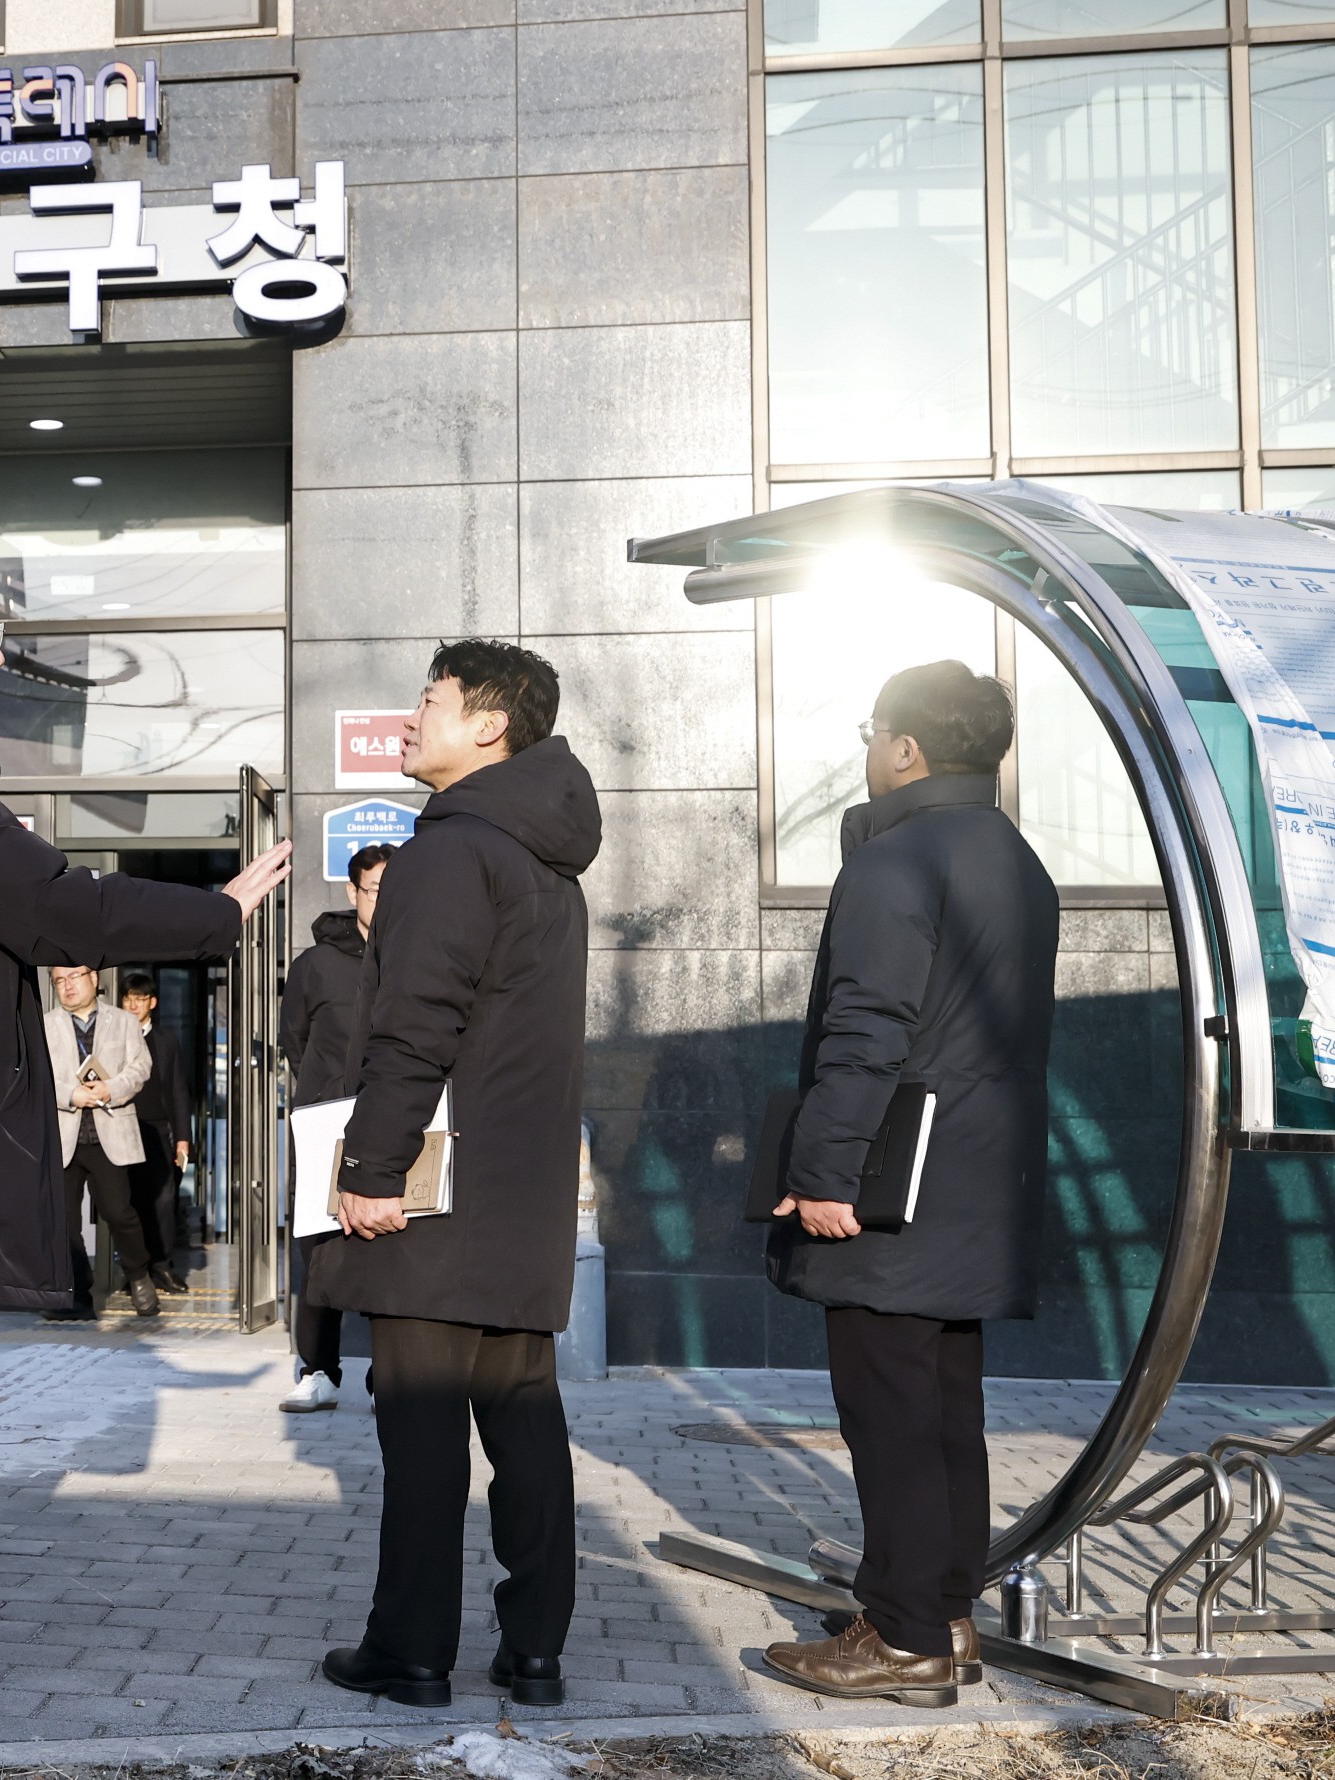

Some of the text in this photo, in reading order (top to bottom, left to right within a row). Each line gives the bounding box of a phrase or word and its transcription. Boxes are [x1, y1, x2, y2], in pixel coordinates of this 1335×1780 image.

[42, 145, 84, 162] CITY
[350, 736, 400, 757] 에스원
[354, 811, 398, 823] 최루백로
[347, 823, 405, 832] Choerubaek-ro
